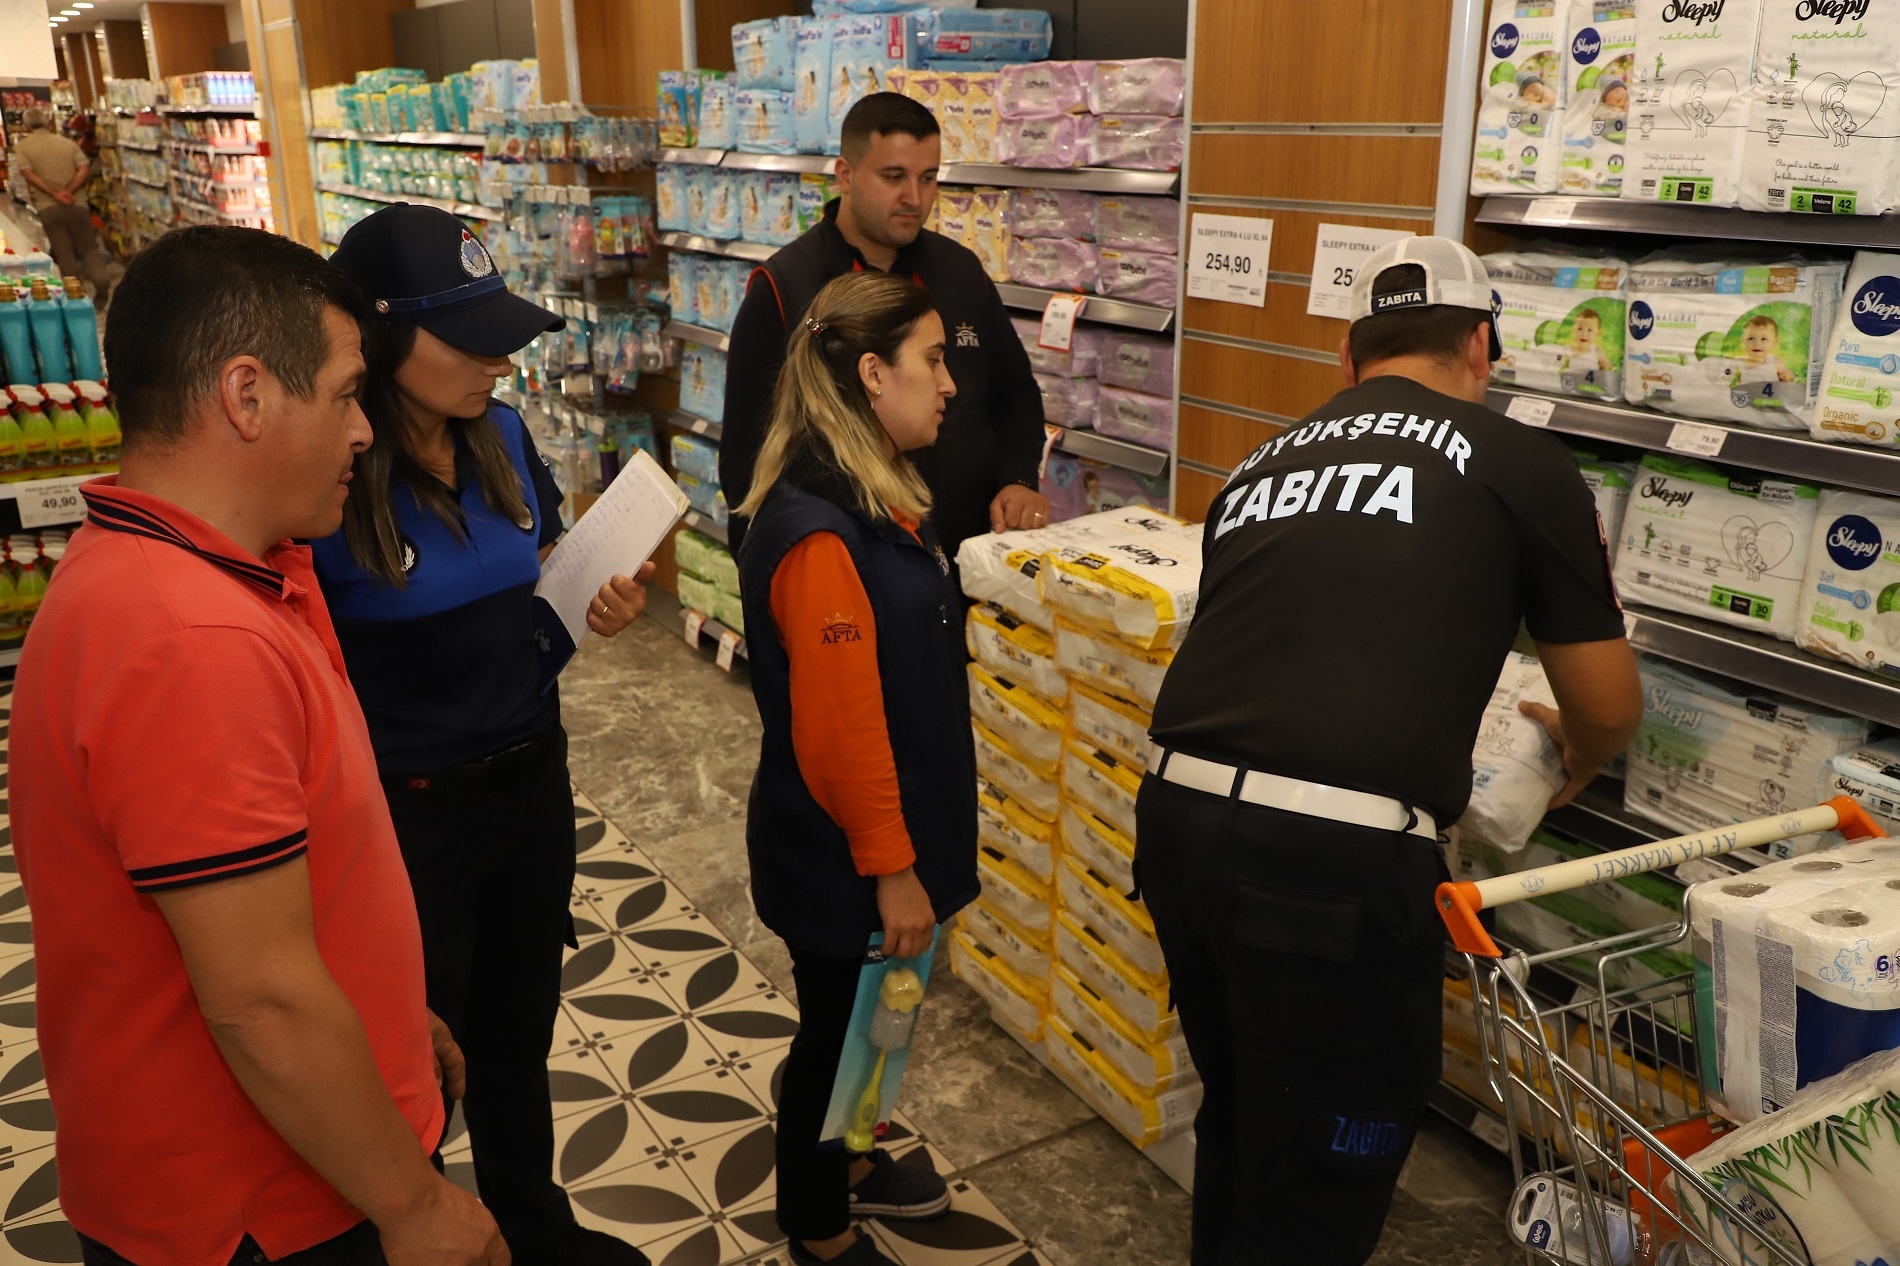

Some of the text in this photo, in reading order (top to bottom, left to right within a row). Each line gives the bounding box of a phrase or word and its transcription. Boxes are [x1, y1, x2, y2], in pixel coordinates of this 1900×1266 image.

[1659, 25, 1722, 41] natural
[1791, 23, 1868, 40] natural
[1808, 162, 1822, 170] better
[1824, 162, 1839, 171] world
[1666, 184, 1672, 192] 2
[1698, 186, 1710, 195] 42
[1768, 189, 1784, 197] zero
[1797, 195, 1804, 204] 2
[1838, 200, 1852, 209] 42
[1197, 228, 1218, 236] SLEEPY
[1321, 240, 1347, 249] SLEEPY
[1348, 242, 1370, 251] EXTRA
[1206, 252, 1251, 276] 254,90
[1333, 267, 1360, 287] 25
[1769, 275, 1795, 286] Organic
[1378, 292, 1422, 308] ZABITA
[1656, 314, 1697, 322] NATURAL
[1839, 339, 1861, 353] Pure
[1585, 370, 1594, 383] 4
[1830, 373, 1866, 388] Natural
[1762, 383, 1774, 397] 4
[1823, 407, 1858, 422] Organic
[1220, 411, 1473, 491] BÜYÜKŞEHİR
[1640, 475, 1694, 508] Sleepy
[1214, 463, 1415, 541] ZABITA
[1828, 526, 1880, 558] Sleepy
[1820, 570, 1835, 583] Saf
[1756, 603, 1769, 614] 30
[1814, 601, 1839, 618] Doğal
[821, 628, 863, 644] AFTA
[1644, 685, 1703, 730] Sleepy
[1834, 776, 1865, 798] Sleepy
[1592, 831, 1737, 881] AFTA MARKET
[1876, 954, 1890, 973] 6
